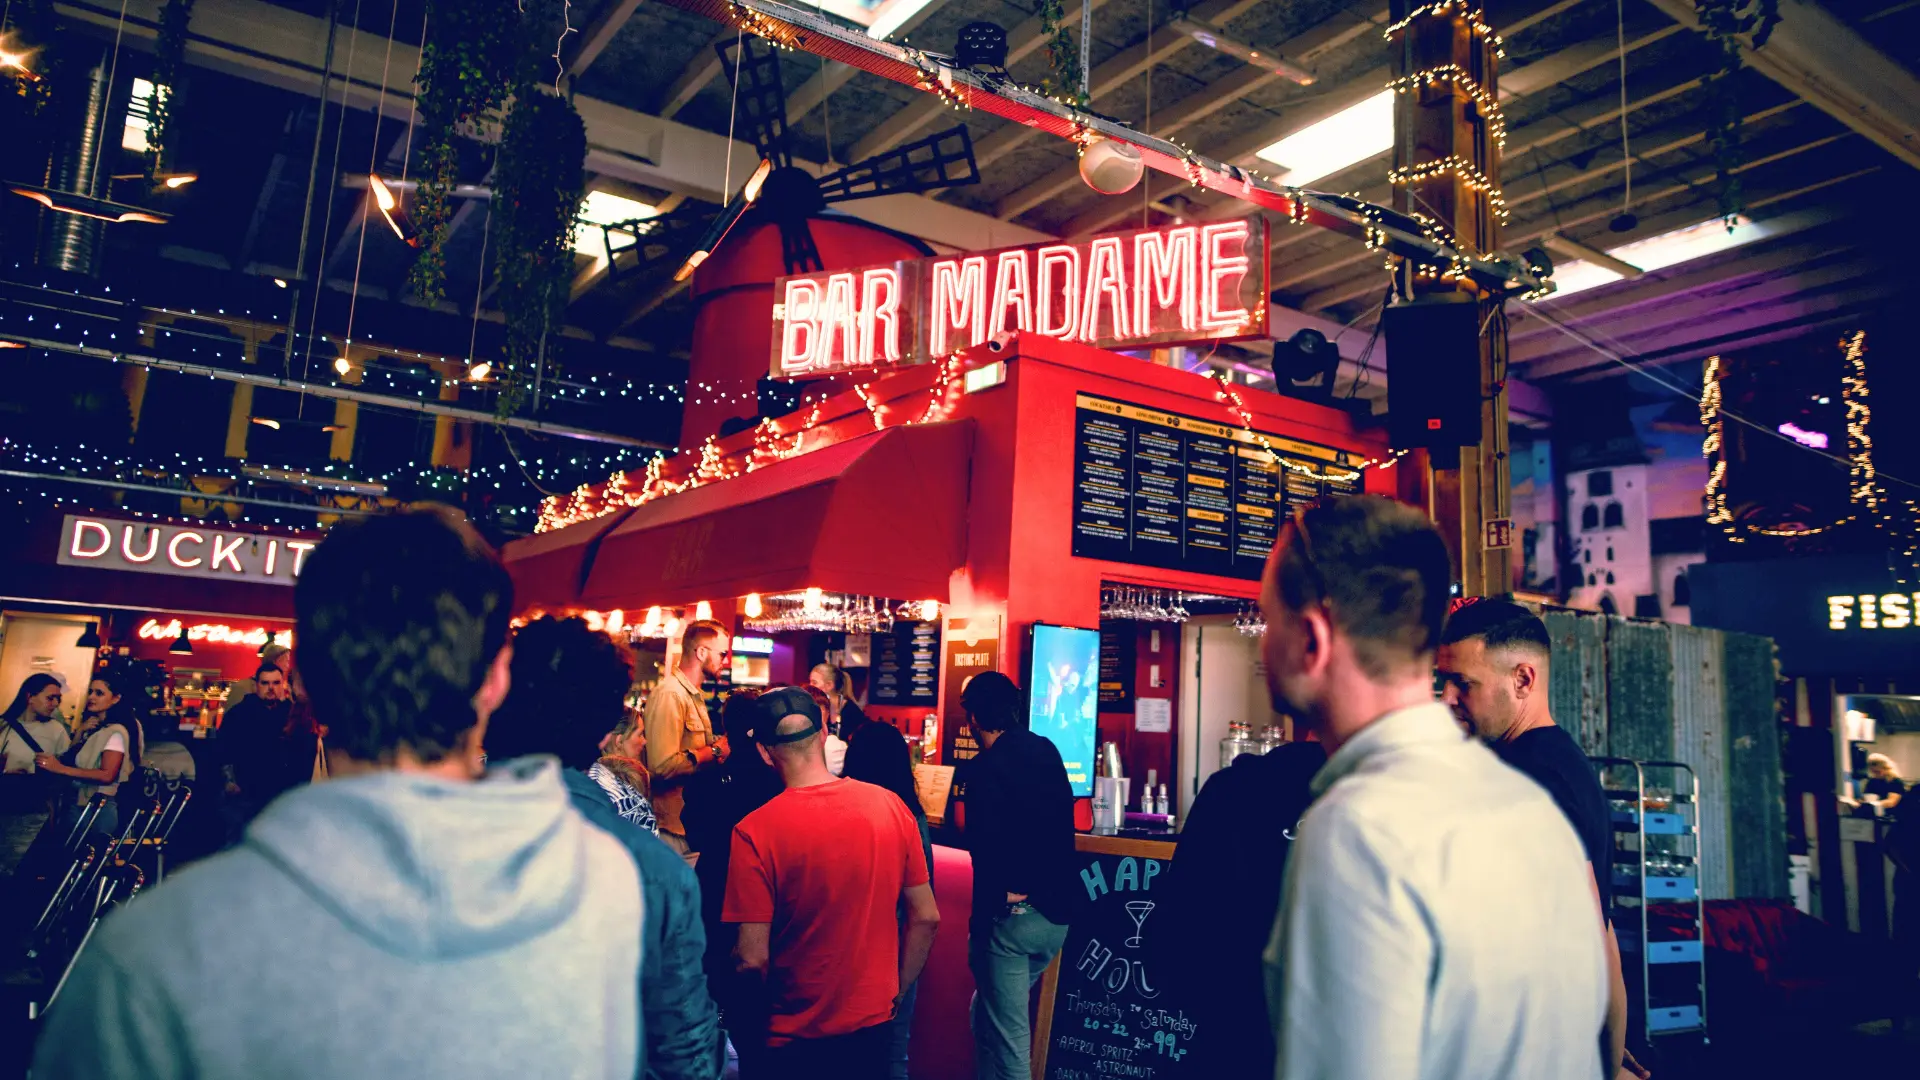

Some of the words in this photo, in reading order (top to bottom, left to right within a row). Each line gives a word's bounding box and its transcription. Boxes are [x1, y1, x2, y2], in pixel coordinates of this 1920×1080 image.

[781, 268, 900, 370] BAR
[930, 220, 1249, 356] MADAME
[71, 519, 245, 572] DUCK
[1079, 856, 1163, 902] HAP
[1066, 989, 1125, 1024] Thursday
